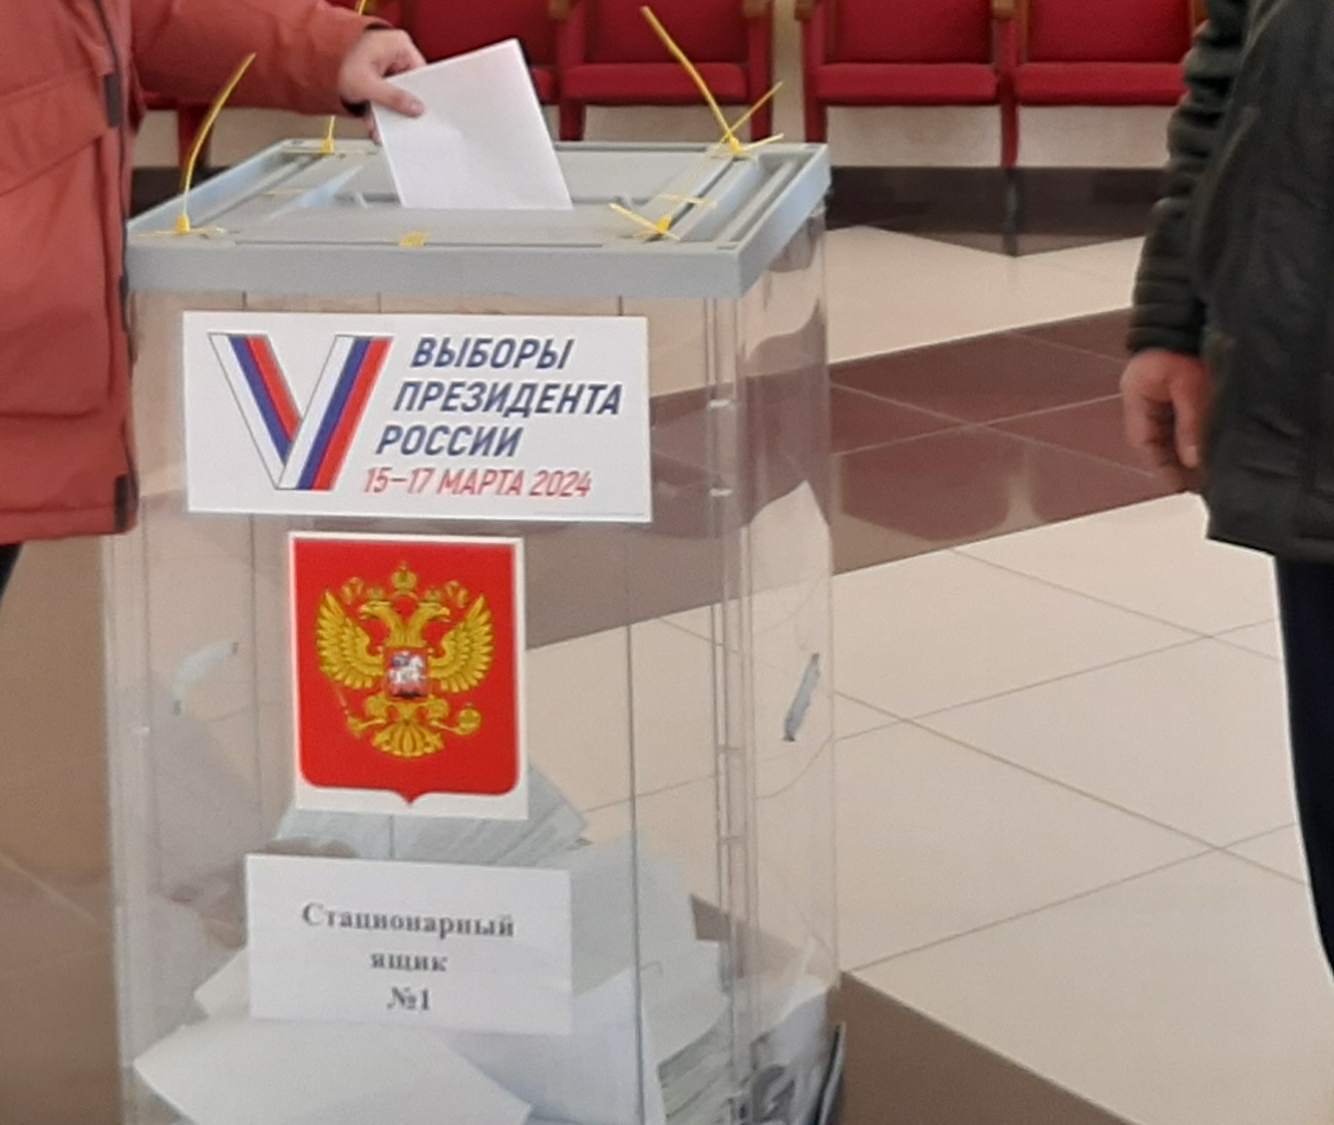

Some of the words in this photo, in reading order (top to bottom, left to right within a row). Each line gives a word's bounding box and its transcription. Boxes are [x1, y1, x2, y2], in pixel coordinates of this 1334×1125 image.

[410, 336, 575, 370] ВЫБОРЫ
[392, 380, 622, 419] ПРЕЗИДЕНТА
[375, 424, 524, 458] РОССИИ
[438, 468, 524, 496] МАРТА
[529, 469, 592, 498] 2024
[302, 901, 514, 940] Стационарный
[370, 952, 448, 973] ящик
[386, 985, 430, 1011] №1
